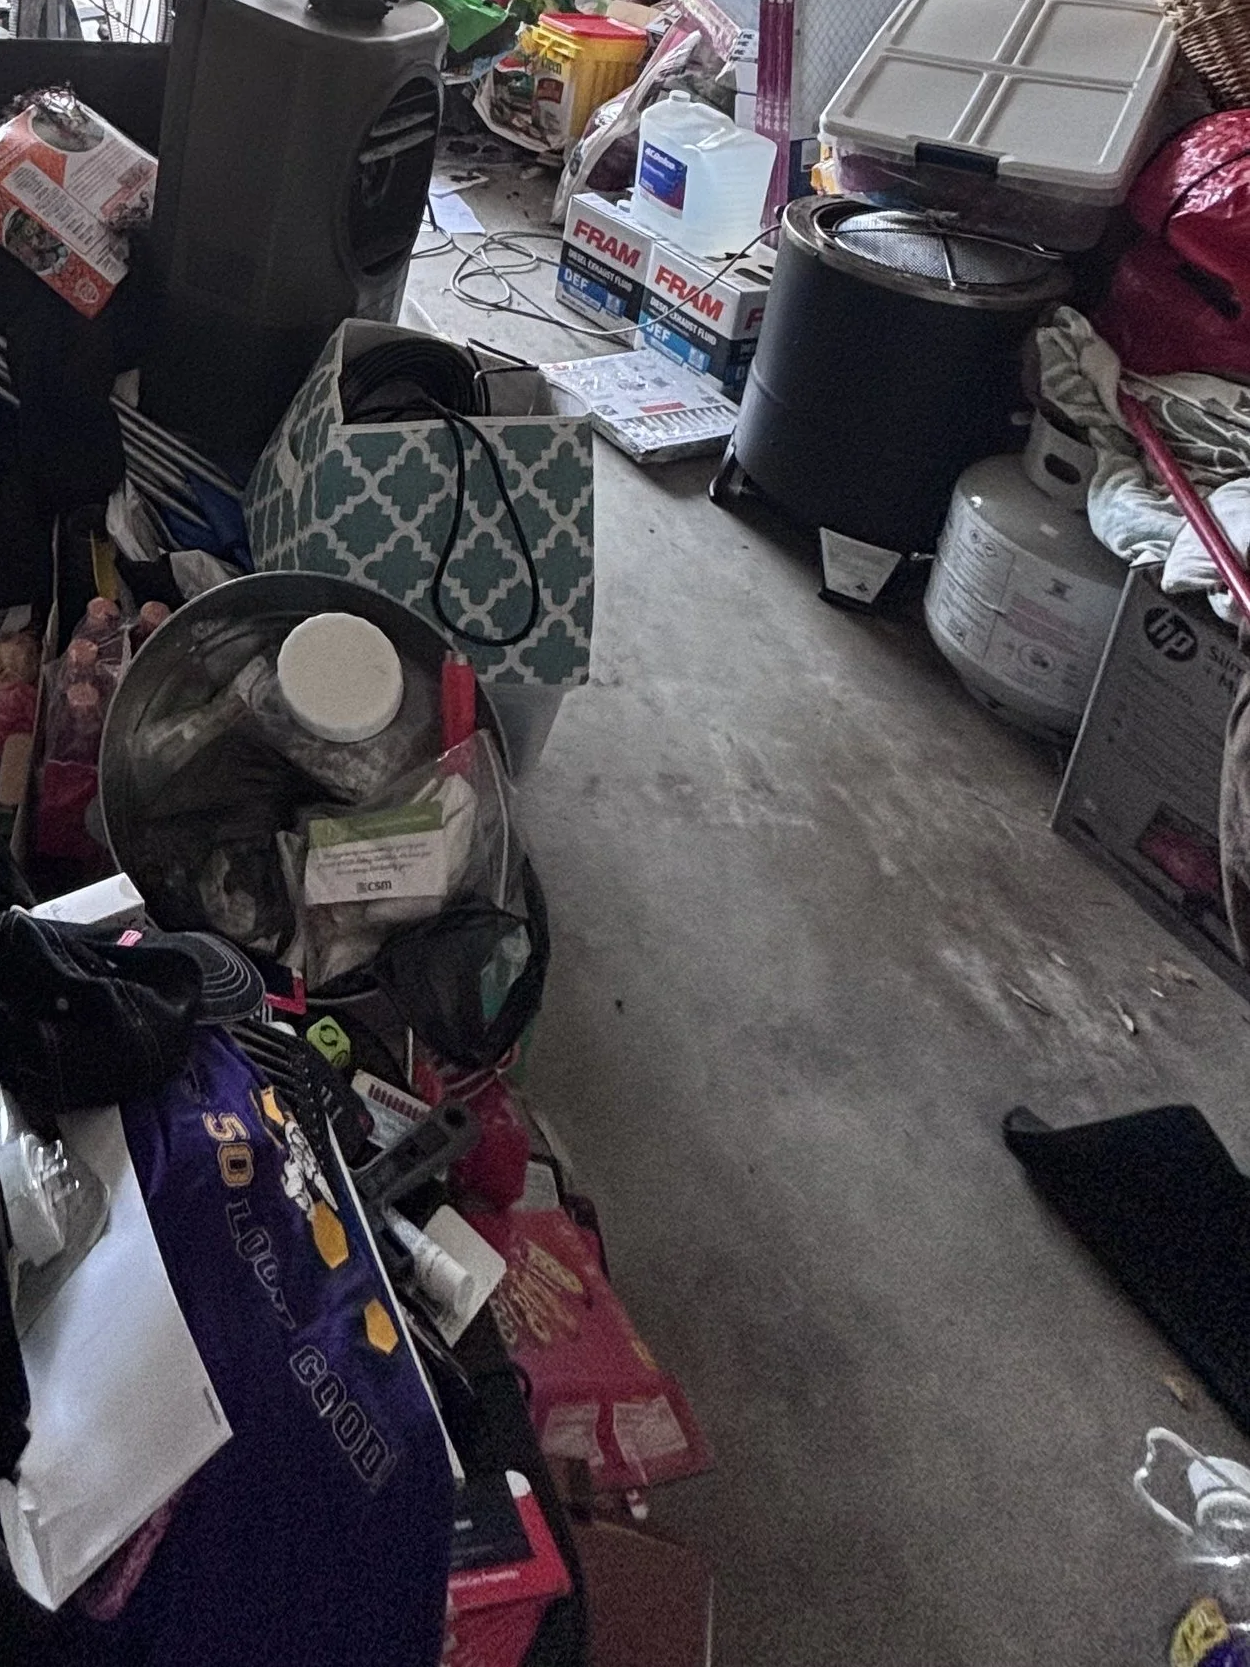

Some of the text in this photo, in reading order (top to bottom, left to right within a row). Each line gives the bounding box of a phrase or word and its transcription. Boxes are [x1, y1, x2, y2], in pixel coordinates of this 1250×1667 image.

[572, 218, 642, 269] FRAM
[564, 267, 589, 291] DEF
[654, 264, 724, 322] FRAM
[1149, 607, 1195, 655] hp
[367, 879, 392, 892] csm
[201, 1110, 255, 1187] SO
